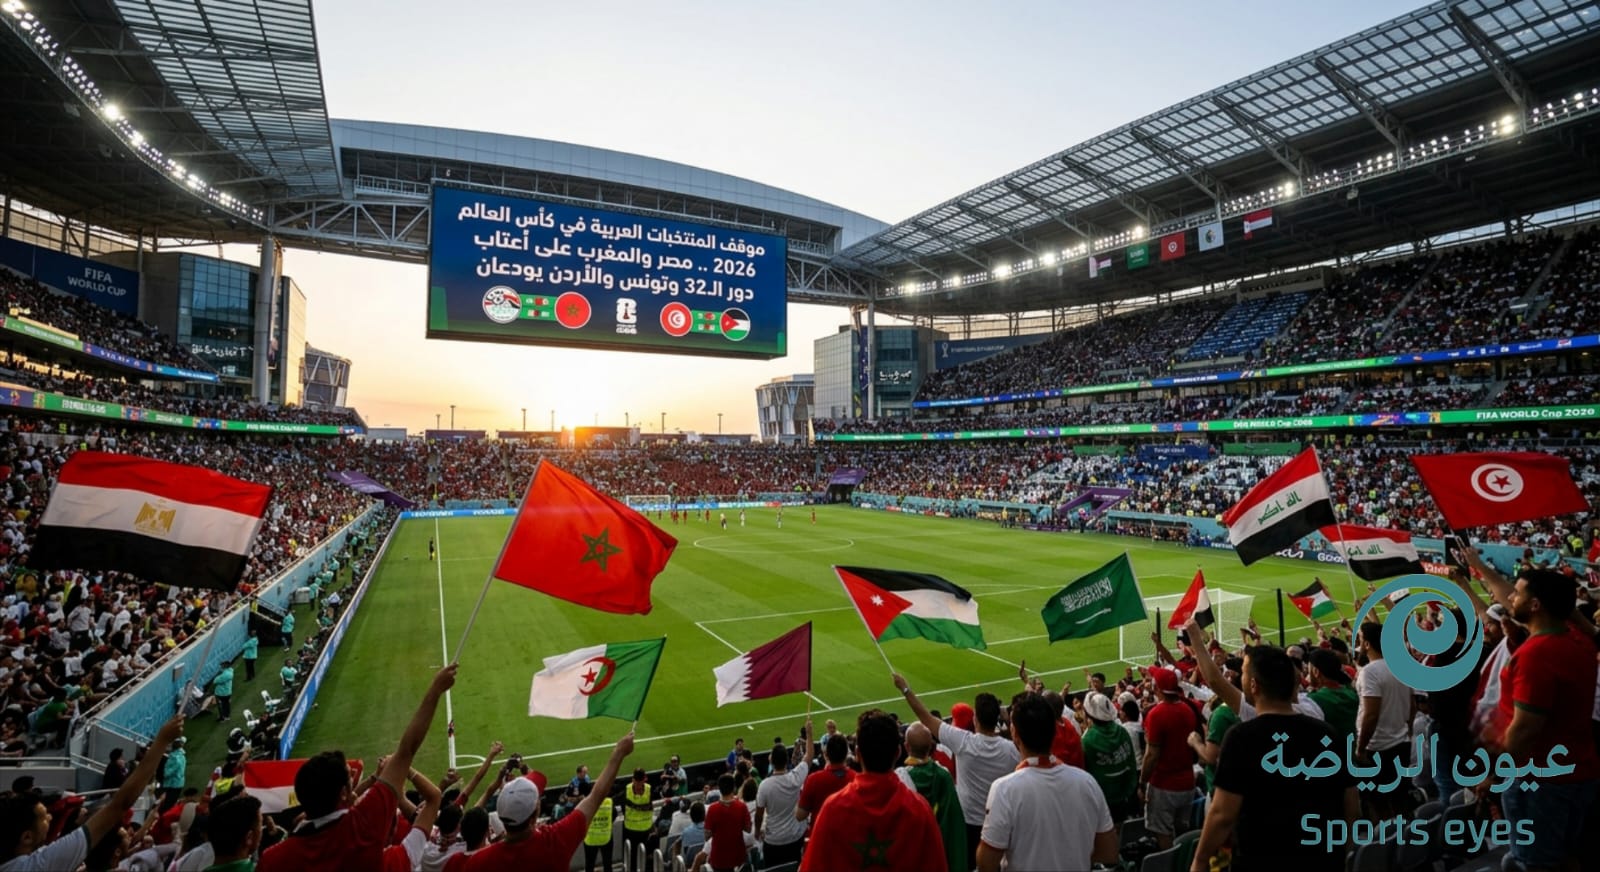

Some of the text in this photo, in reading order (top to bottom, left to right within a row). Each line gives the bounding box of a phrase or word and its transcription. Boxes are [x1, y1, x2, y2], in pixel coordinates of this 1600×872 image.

[458, 202, 765, 258] موقف المنتخبات العربية في كأس العالم
[473, 229, 529, 251] أعتاب
[534, 237, 571, 257] على
[577, 244, 652, 269] والمغرب
[476, 256, 543, 282] يودعان
[656, 256, 693, 270] مصر
[713, 257, 756, 278] 2026
[67, 275, 127, 297] WORLD CUP
[84, 267, 112, 283] FIFA
[549, 263, 614, 289] والأردن
[619, 273, 679, 296] وتونس
[726, 287, 754, 302] دور
[1476, 411, 1498, 420] FIFA
[1499, 409, 1539, 419] WORLD
